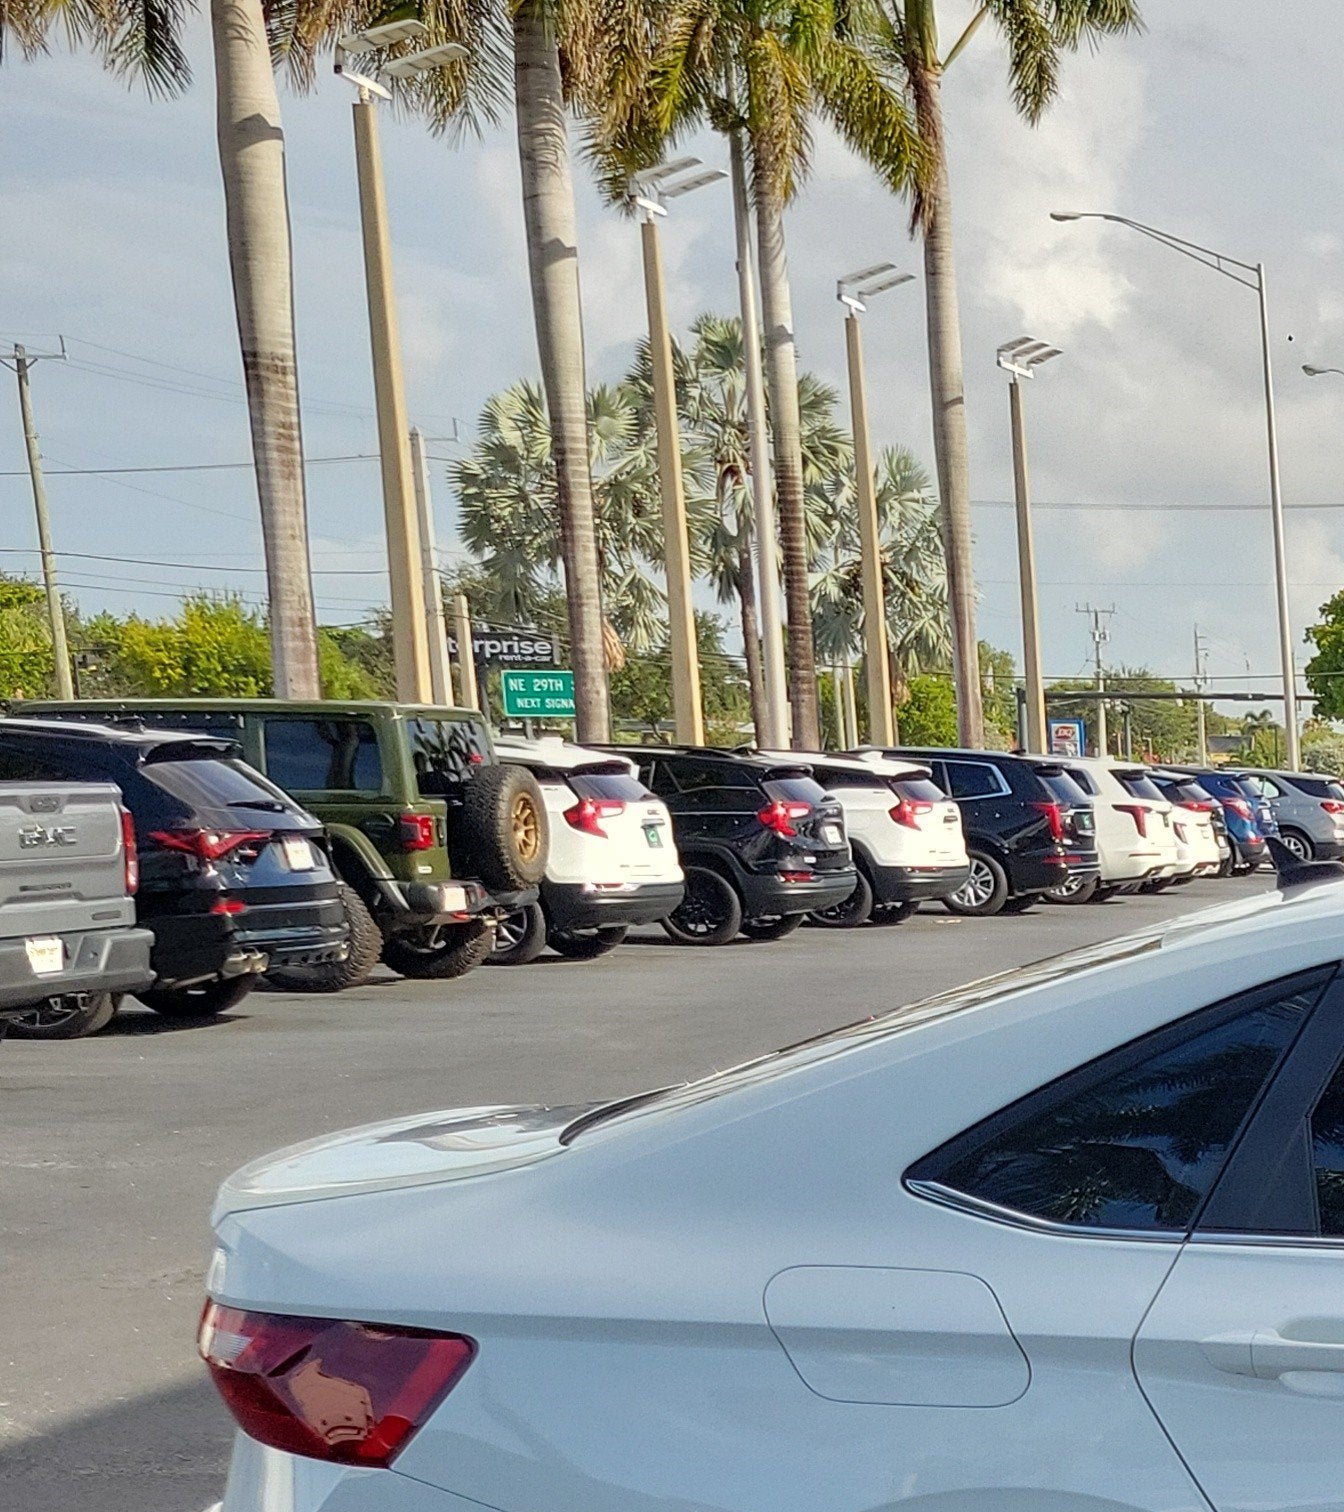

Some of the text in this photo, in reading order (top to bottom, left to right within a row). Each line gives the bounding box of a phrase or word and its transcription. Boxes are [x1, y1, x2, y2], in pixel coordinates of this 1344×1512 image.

[509, 678, 526, 692] NE
[532, 678, 564, 692] 29TH
[516, 697, 576, 709] NEXT SIGNA
